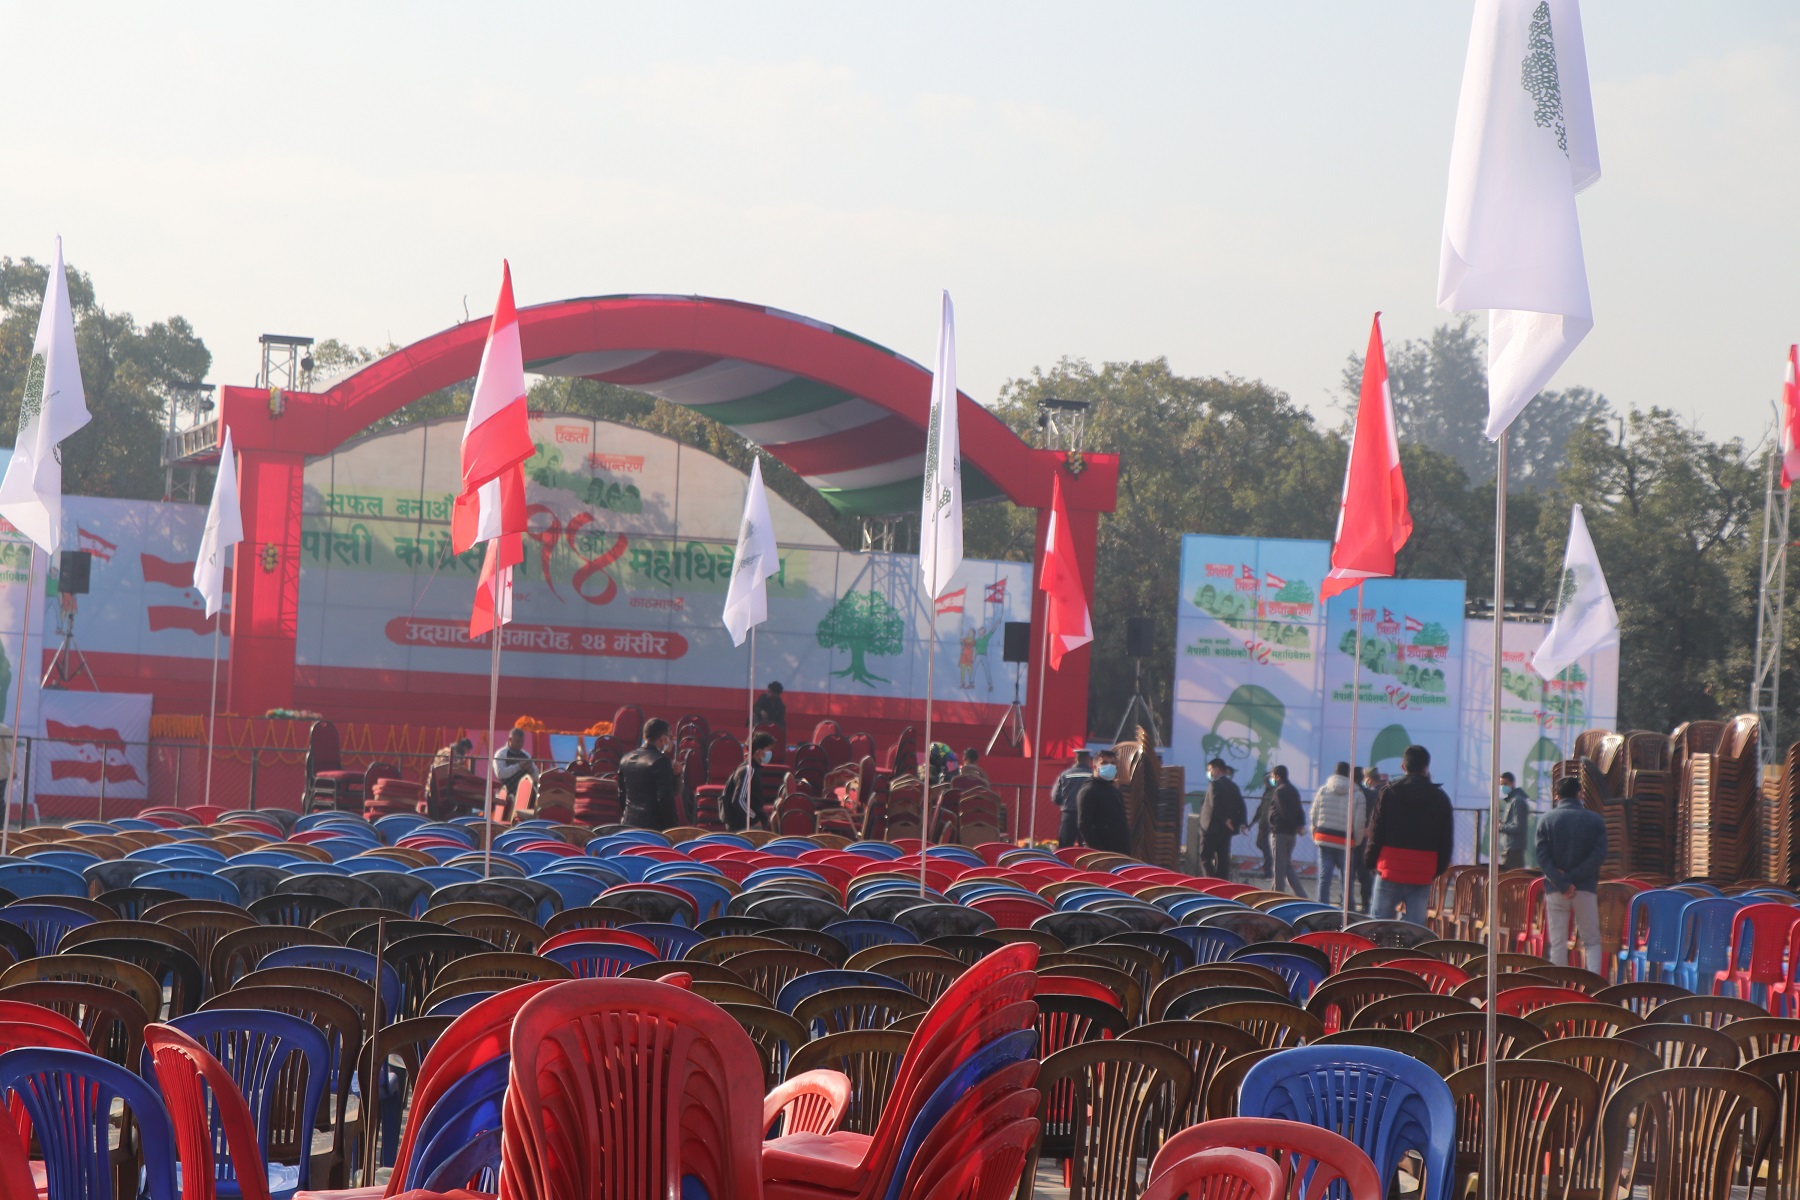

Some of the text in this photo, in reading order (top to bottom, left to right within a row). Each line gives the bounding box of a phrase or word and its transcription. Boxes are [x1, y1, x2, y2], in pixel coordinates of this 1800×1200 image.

[556, 431, 589, 444] एकता
[326, 493, 383, 517] सफल
[301, 523, 372, 566] पाली
[394, 531, 526, 575] कांग्रेस
[629, 541, 785, 588] महाधिवेन
[614, 632, 669, 655] मंसीर
